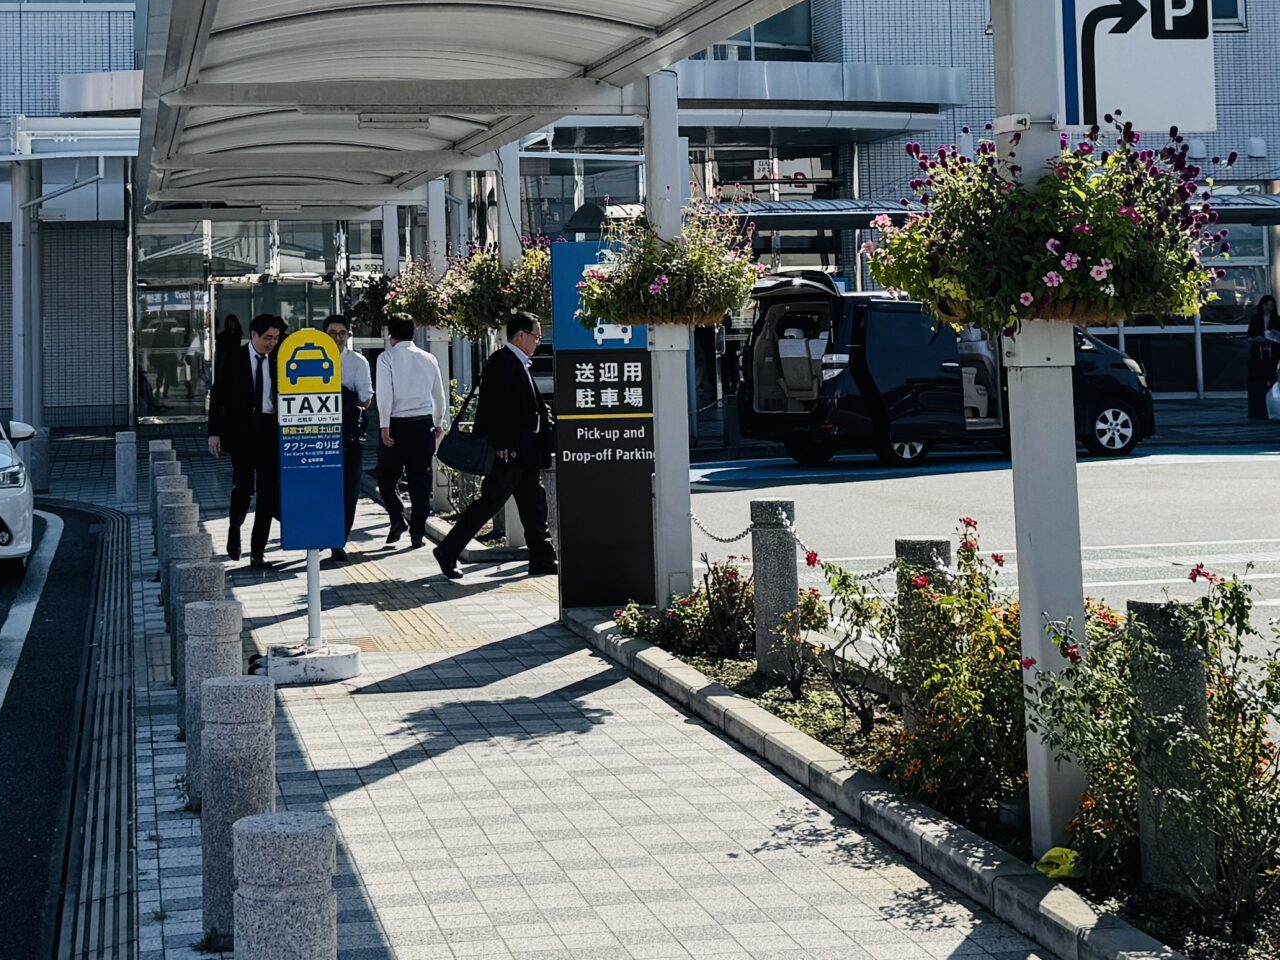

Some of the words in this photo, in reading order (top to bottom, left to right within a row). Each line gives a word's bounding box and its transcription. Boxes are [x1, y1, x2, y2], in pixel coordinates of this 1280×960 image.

[575, 362, 643, 383] 送迎用
[282, 395, 339, 414] TAXI
[575, 387, 644, 409] 駐車場
[576, 427, 620, 442] Pick-up
[623, 426, 645, 439] and
[283, 440, 340, 450] タクシーのりば
[562, 450, 612, 464] Drop-off
